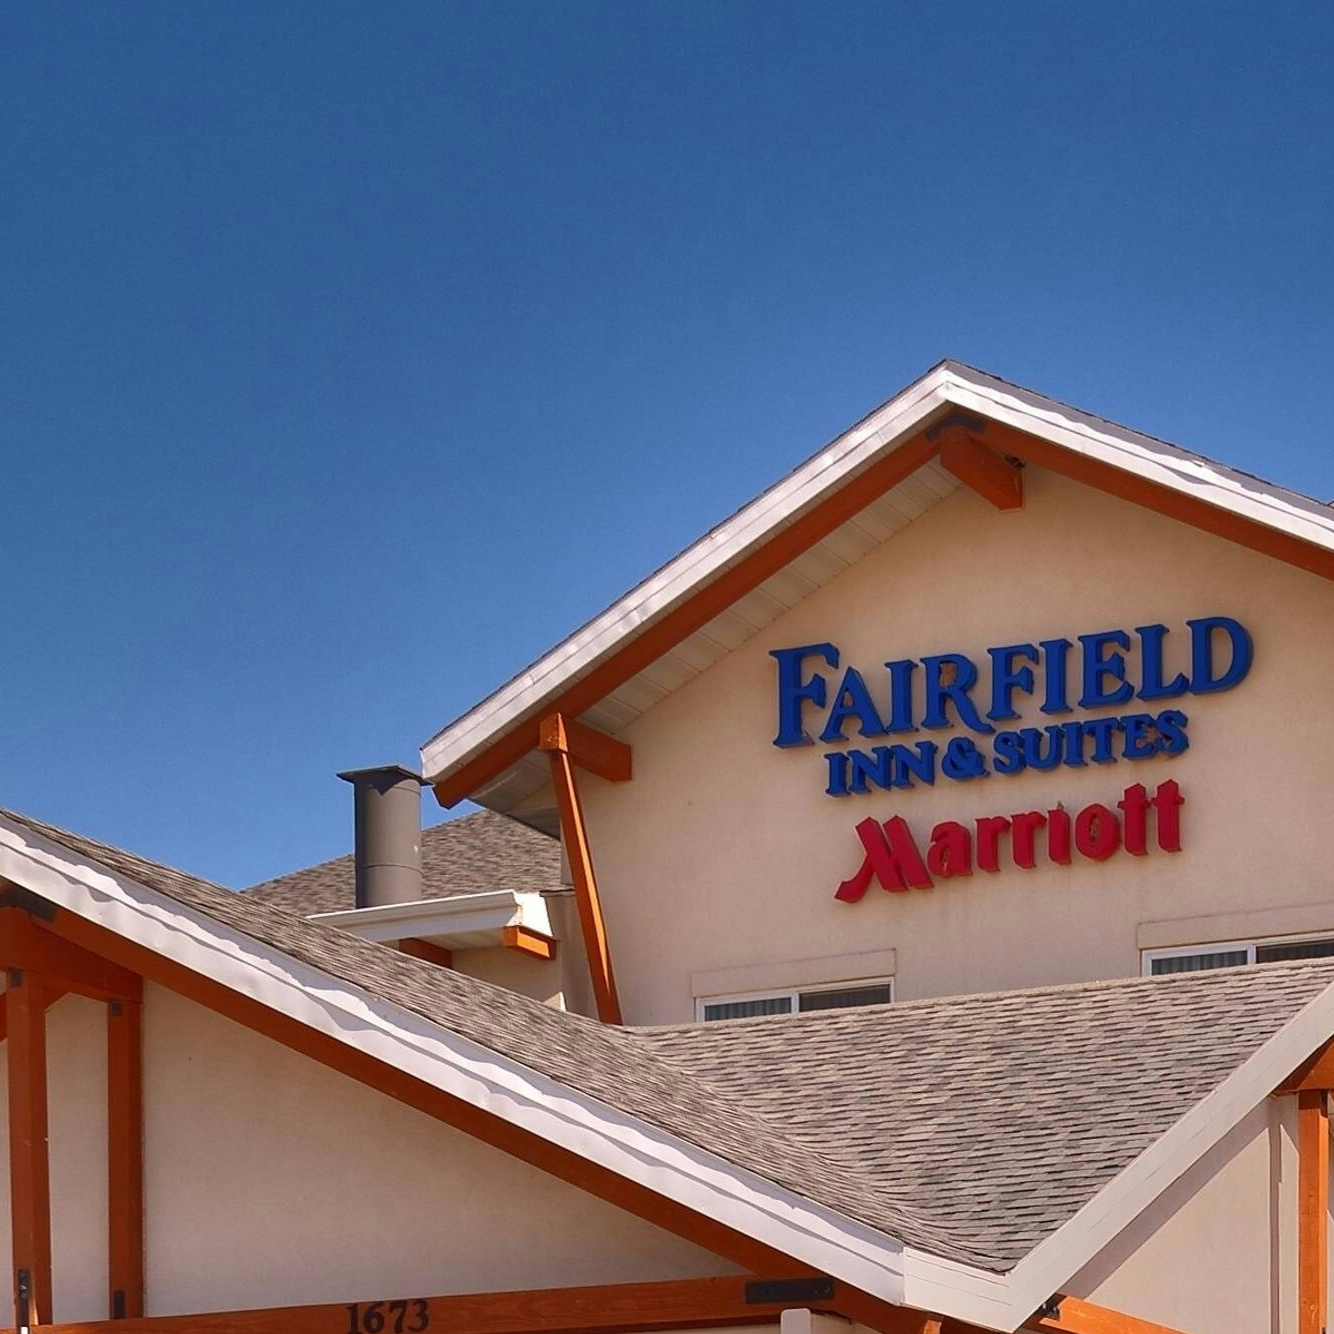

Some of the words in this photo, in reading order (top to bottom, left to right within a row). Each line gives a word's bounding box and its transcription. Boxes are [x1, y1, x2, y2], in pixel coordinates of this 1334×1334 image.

[769, 616, 1253, 749] FAIRFIELD
[825, 741, 937, 798] INN
[992, 709, 1190, 774] SUITES
[833, 778, 1185, 904] Marriott
